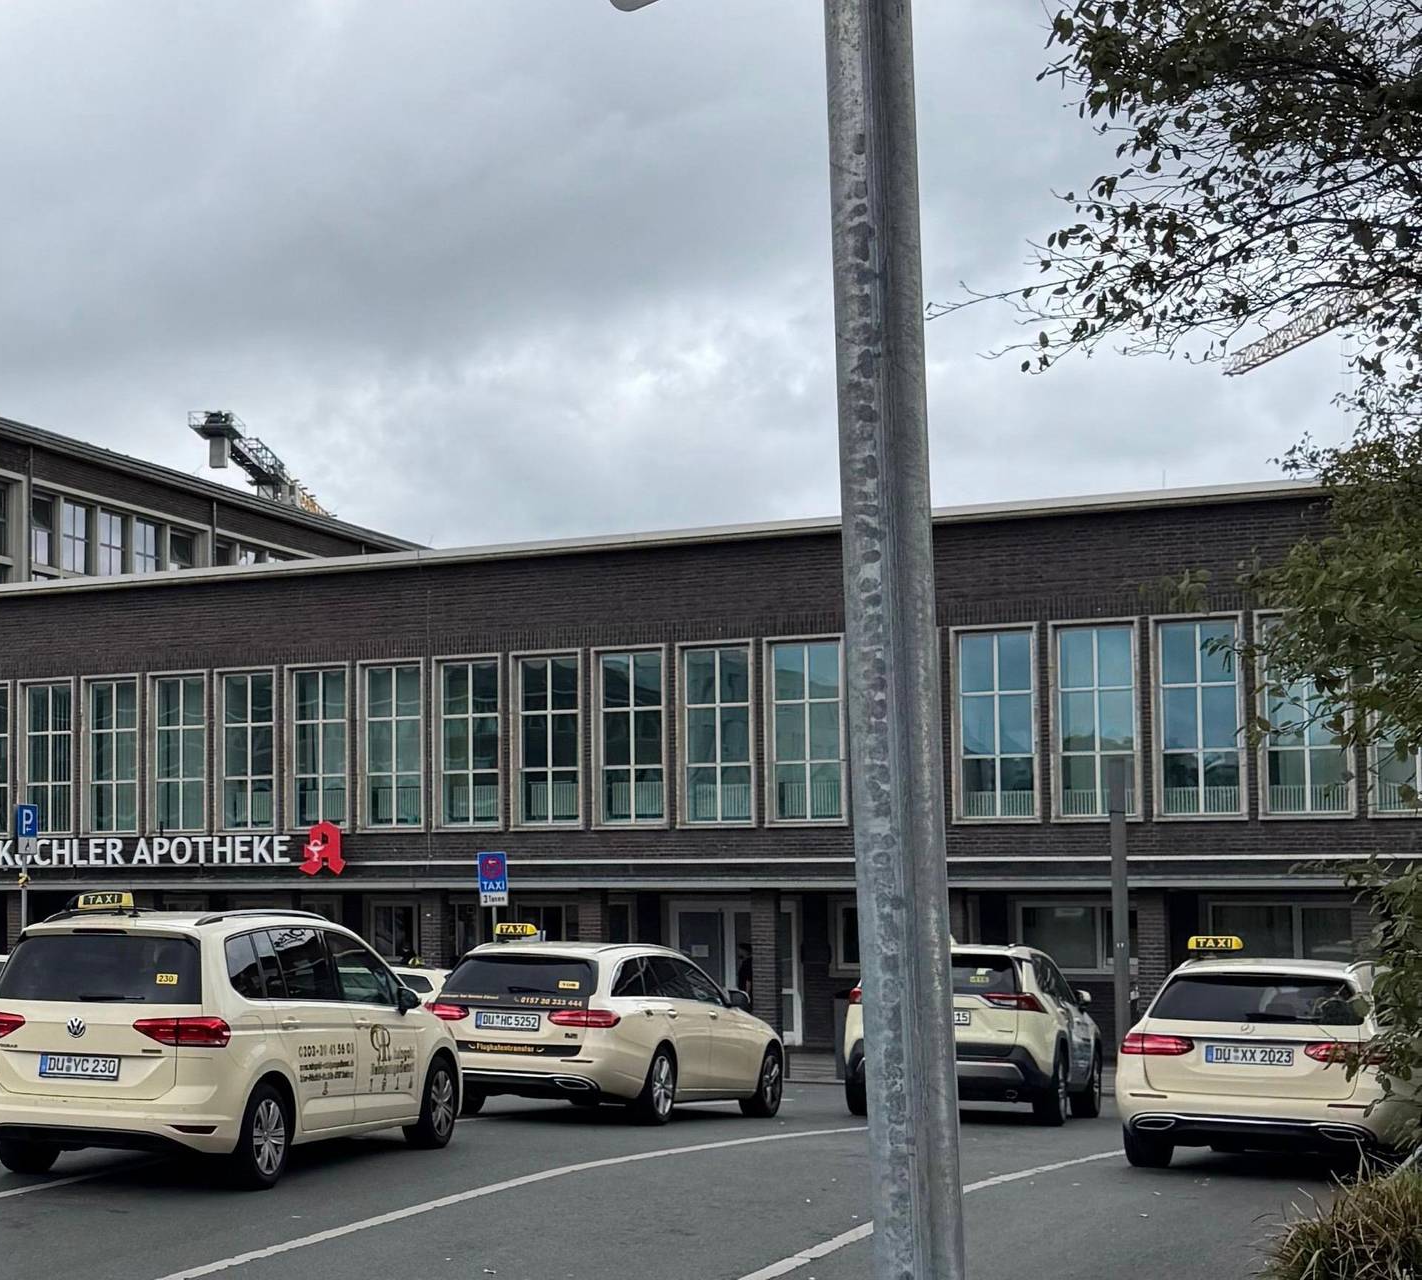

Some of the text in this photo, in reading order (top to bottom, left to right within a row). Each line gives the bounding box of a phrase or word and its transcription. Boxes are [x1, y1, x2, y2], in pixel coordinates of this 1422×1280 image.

[23, 809, 33, 834] P
[132, 836, 291, 864] APOTHEKE
[482, 881, 505, 890] TAXI
[88, 895, 118, 905] TAXI
[501, 925, 527, 933] TAXI
[1197, 939, 1231, 947] TAXI
[482, 1014, 537, 1027] DU HC 5252
[476, 1043, 535, 1052] Flughafentransfer
[1215, 1048, 1292, 1063] DU XX 2023
[48, 1057, 116, 1073] DU YC 230
